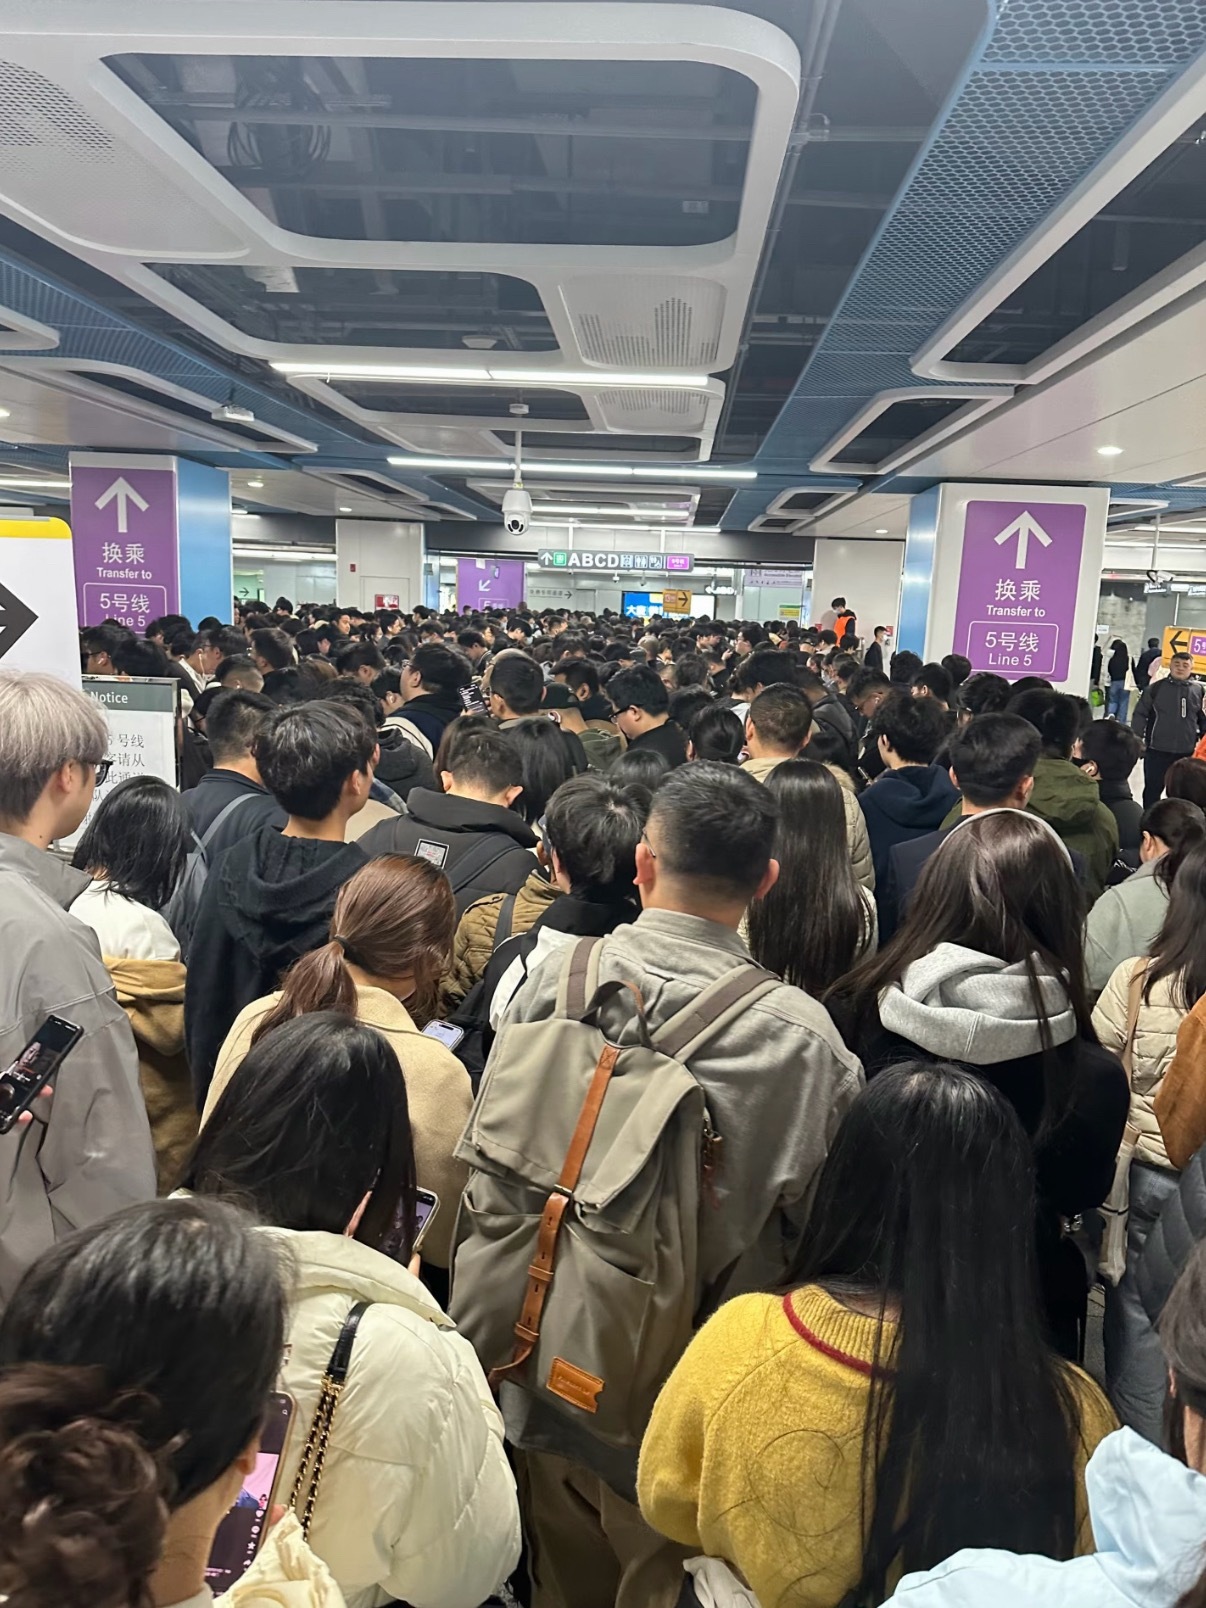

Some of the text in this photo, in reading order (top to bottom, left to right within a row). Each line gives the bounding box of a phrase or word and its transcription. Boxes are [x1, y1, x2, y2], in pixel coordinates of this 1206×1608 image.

[102, 542, 145, 564] 换乘
[567, 552, 619, 567] ABCD
[96, 567, 152, 579] Transfer to
[994, 578, 1041, 602] 换乘
[100, 593, 150, 613] 5号线
[986, 605, 1046, 617] Transfer to
[137, 615, 146, 627] 5
[985, 631, 1039, 652] 5号线
[988, 653, 1032, 666] Line 5
[90, 691, 128, 704] Notice
